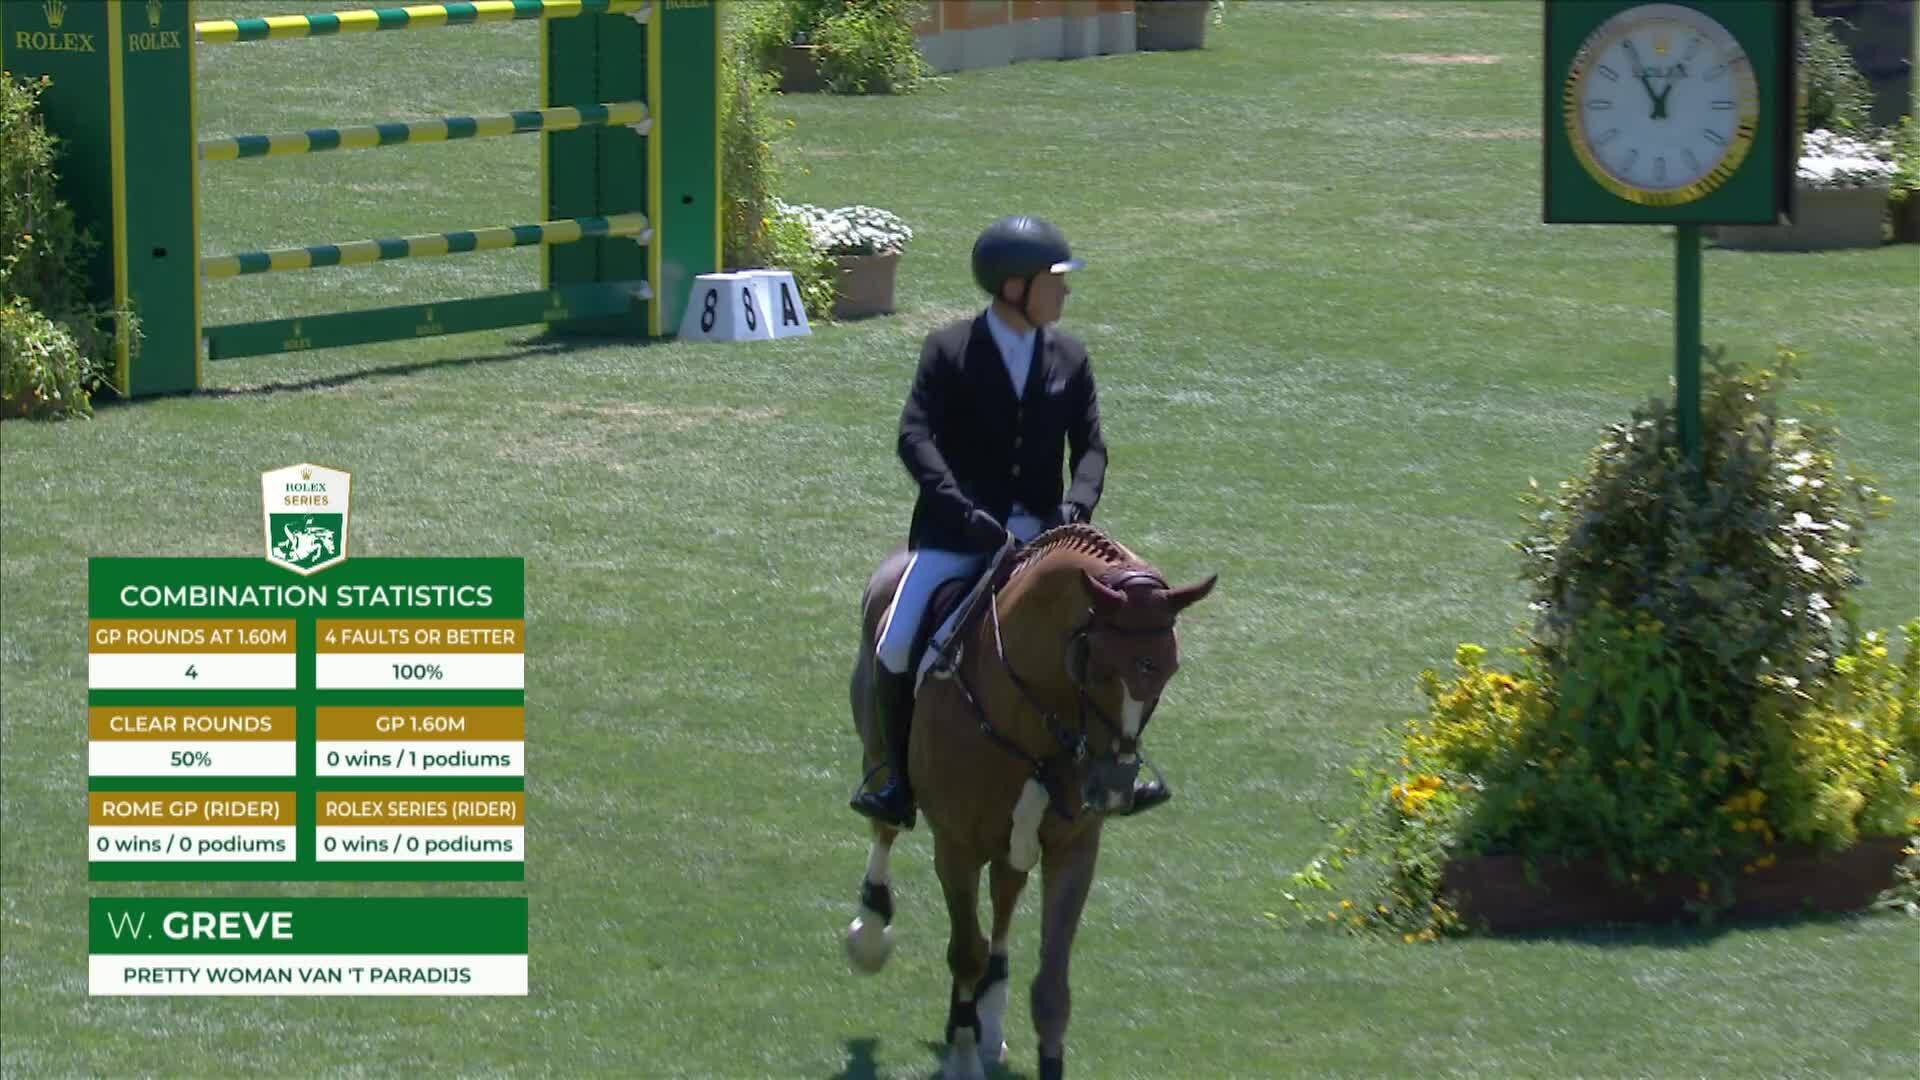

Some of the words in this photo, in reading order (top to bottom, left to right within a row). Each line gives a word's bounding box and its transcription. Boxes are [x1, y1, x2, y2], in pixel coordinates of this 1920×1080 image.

[16, 31, 95, 52] ROLEX
[129, 31, 181, 51] ROLEX
[701, 288, 718, 333] 8
[742, 286, 756, 332] 8
[781, 282, 800, 326] A
